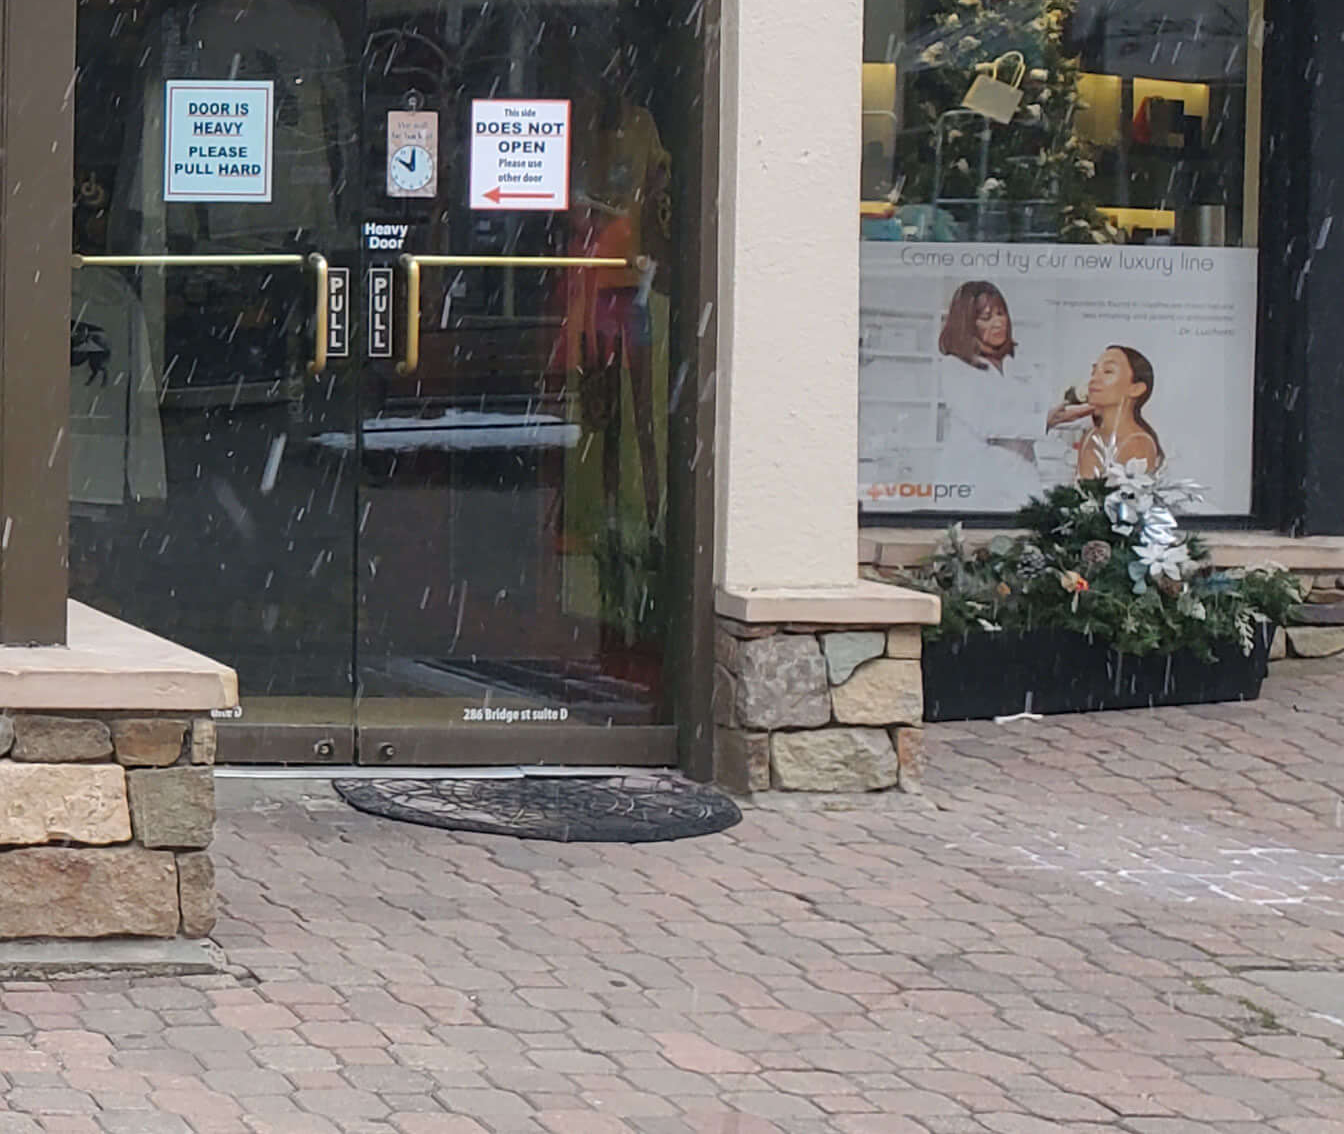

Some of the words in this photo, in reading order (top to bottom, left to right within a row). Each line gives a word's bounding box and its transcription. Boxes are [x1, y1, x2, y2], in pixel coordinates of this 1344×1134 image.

[188, 102, 230, 115] DOOR
[235, 102, 249, 115] IS
[504, 108, 519, 117] This
[521, 108, 537, 117] side
[193, 121, 243, 134] HEAVY
[475, 121, 522, 134] DOES
[528, 122, 565, 135] NOT
[188, 146, 248, 157] PLEASE
[498, 140, 546, 153] OPEN
[174, 163, 213, 175] PULL
[218, 164, 262, 175] HARD
[498, 158, 526, 168] Please
[527, 159, 543, 168] use
[497, 172, 521, 182] other
[522, 172, 543, 183] door
[363, 222, 408, 237] Heavy
[368, 236, 404, 249] Door
[900, 247, 954, 267] Come
[961, 249, 1000, 267] and
[1007, 249, 1030, 274] try
[1074, 254, 1113, 268] new
[1119, 250, 1173, 276] luxury
[1180, 251, 1214, 272] line
[330, 276, 344, 347] PULL
[374, 277, 388, 348] PULL
[463, 708, 483, 721] 286
[484, 707, 519, 723] Bridge
[520, 708, 531, 721] st
[532, 707, 558, 721] suite
[559, 708, 568, 721] D
